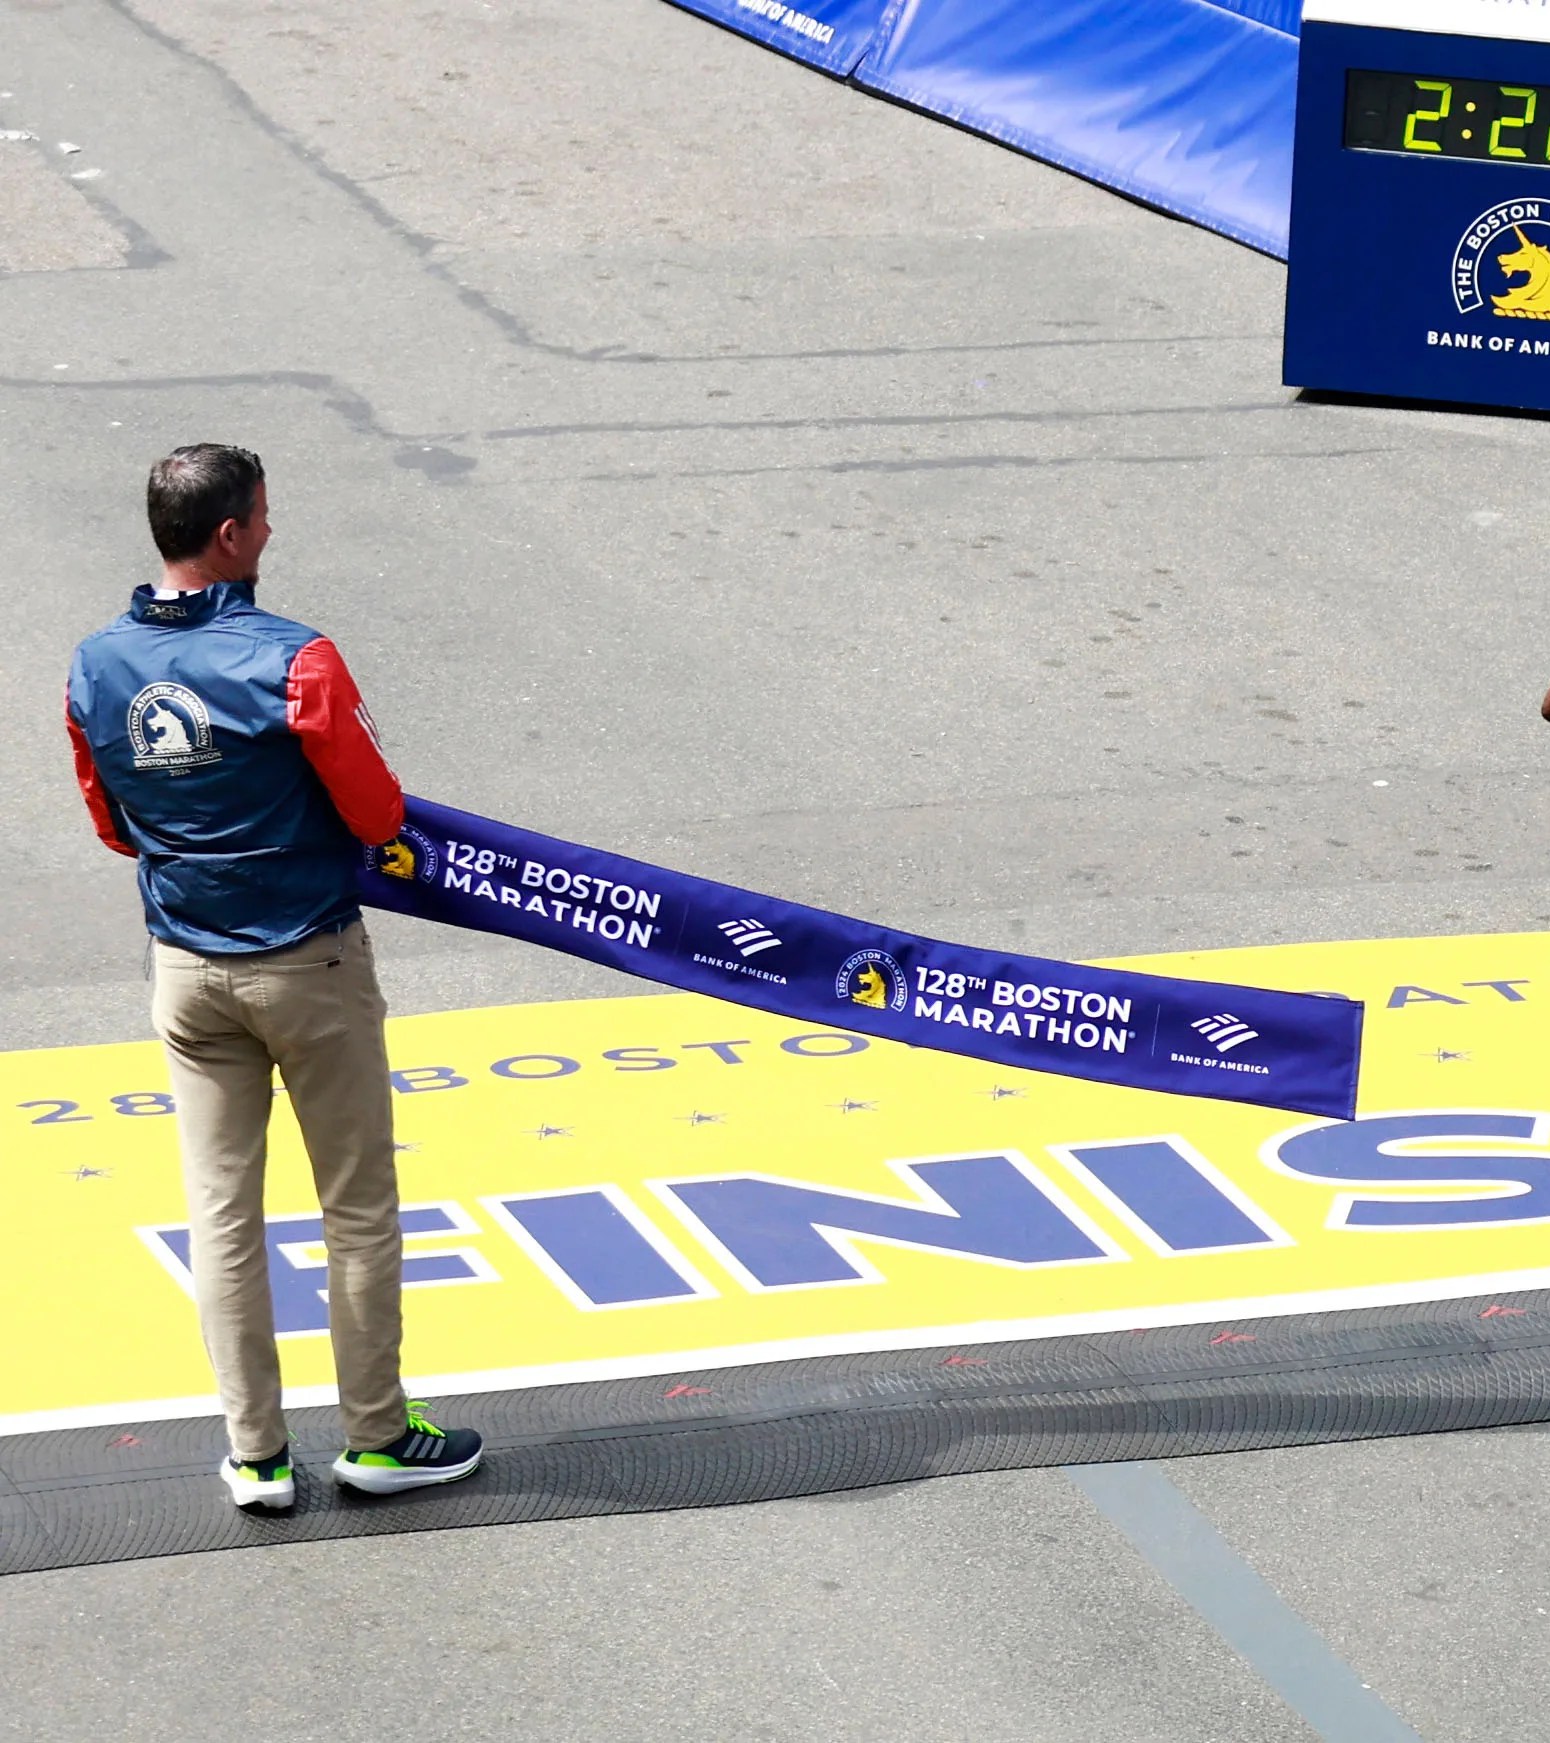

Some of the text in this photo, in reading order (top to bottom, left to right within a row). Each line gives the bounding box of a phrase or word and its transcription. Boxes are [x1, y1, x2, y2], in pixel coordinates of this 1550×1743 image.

[782, 9, 836, 44] AMERICA
[1457, 257, 1473, 300] THE
[1466, 203, 1540, 250] BOSTON
[1426, 330, 1483, 350] BANK
[1488, 336, 1515, 352] OF
[132, 686, 209, 752] BOSTON ATHLETIC ASSOCIATION
[134, 751, 223, 768] BOSTON MARATHON
[445, 840, 662, 919] 128TH BOSTON
[444, 866, 655, 949] MARATHON
[693, 953, 788, 986] BANK OF AMERICA
[838, 952, 905, 1007] 2024 BOSTON MARATHON
[915, 965, 1133, 1023] 128TH BOSTON
[914, 1001, 1129, 1054] MARATHON
[391, 1033, 916, 1094] BOSTO
[1171, 1052, 1270, 1075] BANK OF AMERICA
